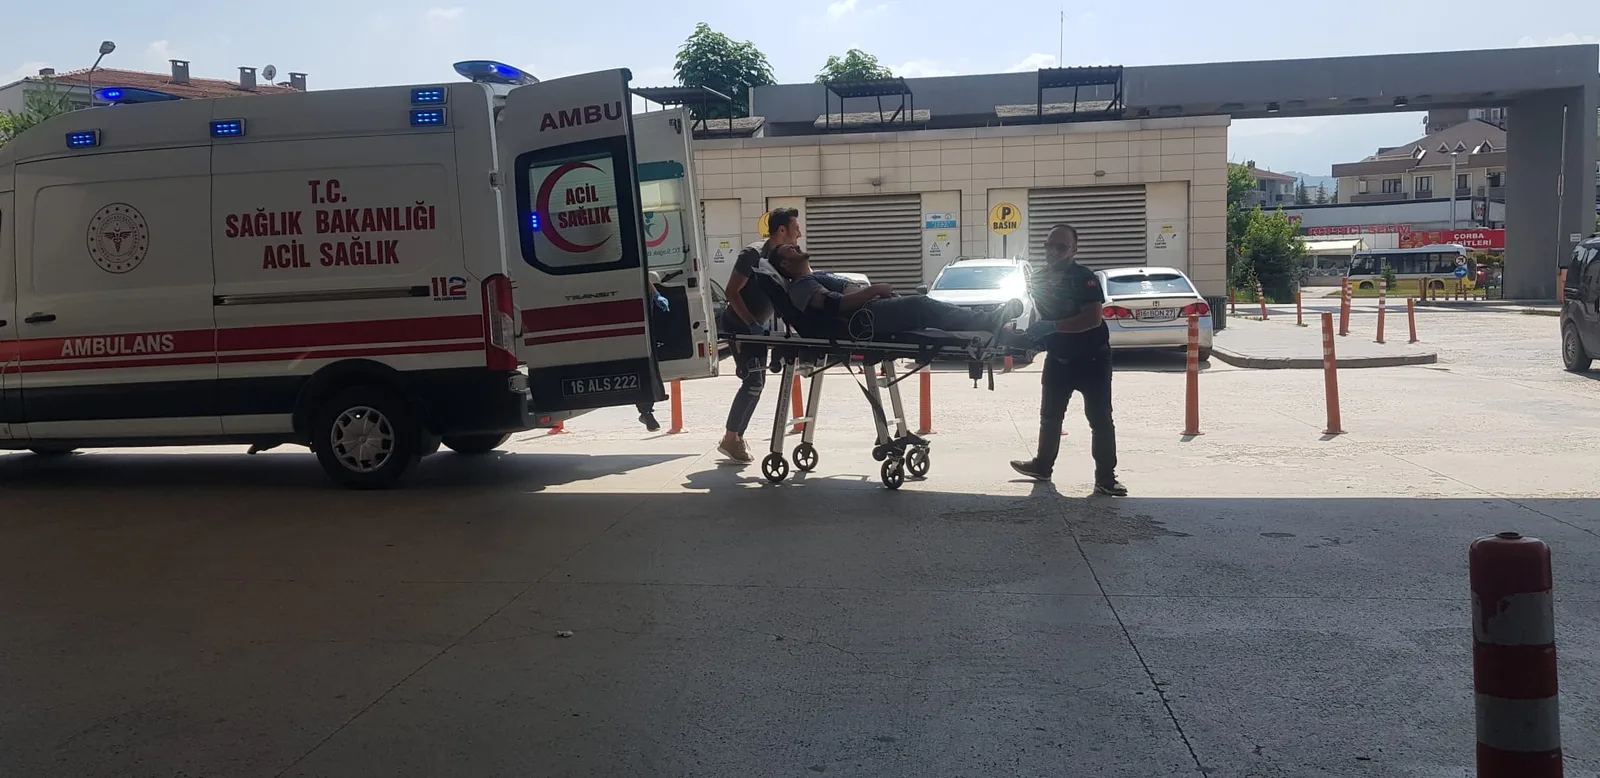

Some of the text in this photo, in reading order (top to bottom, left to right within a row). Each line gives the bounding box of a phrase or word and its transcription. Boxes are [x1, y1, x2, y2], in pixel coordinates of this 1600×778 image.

[539, 101, 623, 132] AMBU
[308, 179, 347, 204] T.C.
[565, 182, 599, 206] ACİL
[225, 200, 436, 238] SAĞLIK BAKANLIĞI
[558, 206, 612, 229] SAĞLIK
[1001, 206, 1011, 220] P
[993, 221, 1017, 230] BASIN
[262, 236, 400, 269] ACİL SAĞLIK
[431, 276, 467, 297] 112
[564, 291, 619, 300] TRANSIT
[61, 333, 174, 357] AMBULANS
[571, 375, 638, 394] 16 ALS 222
